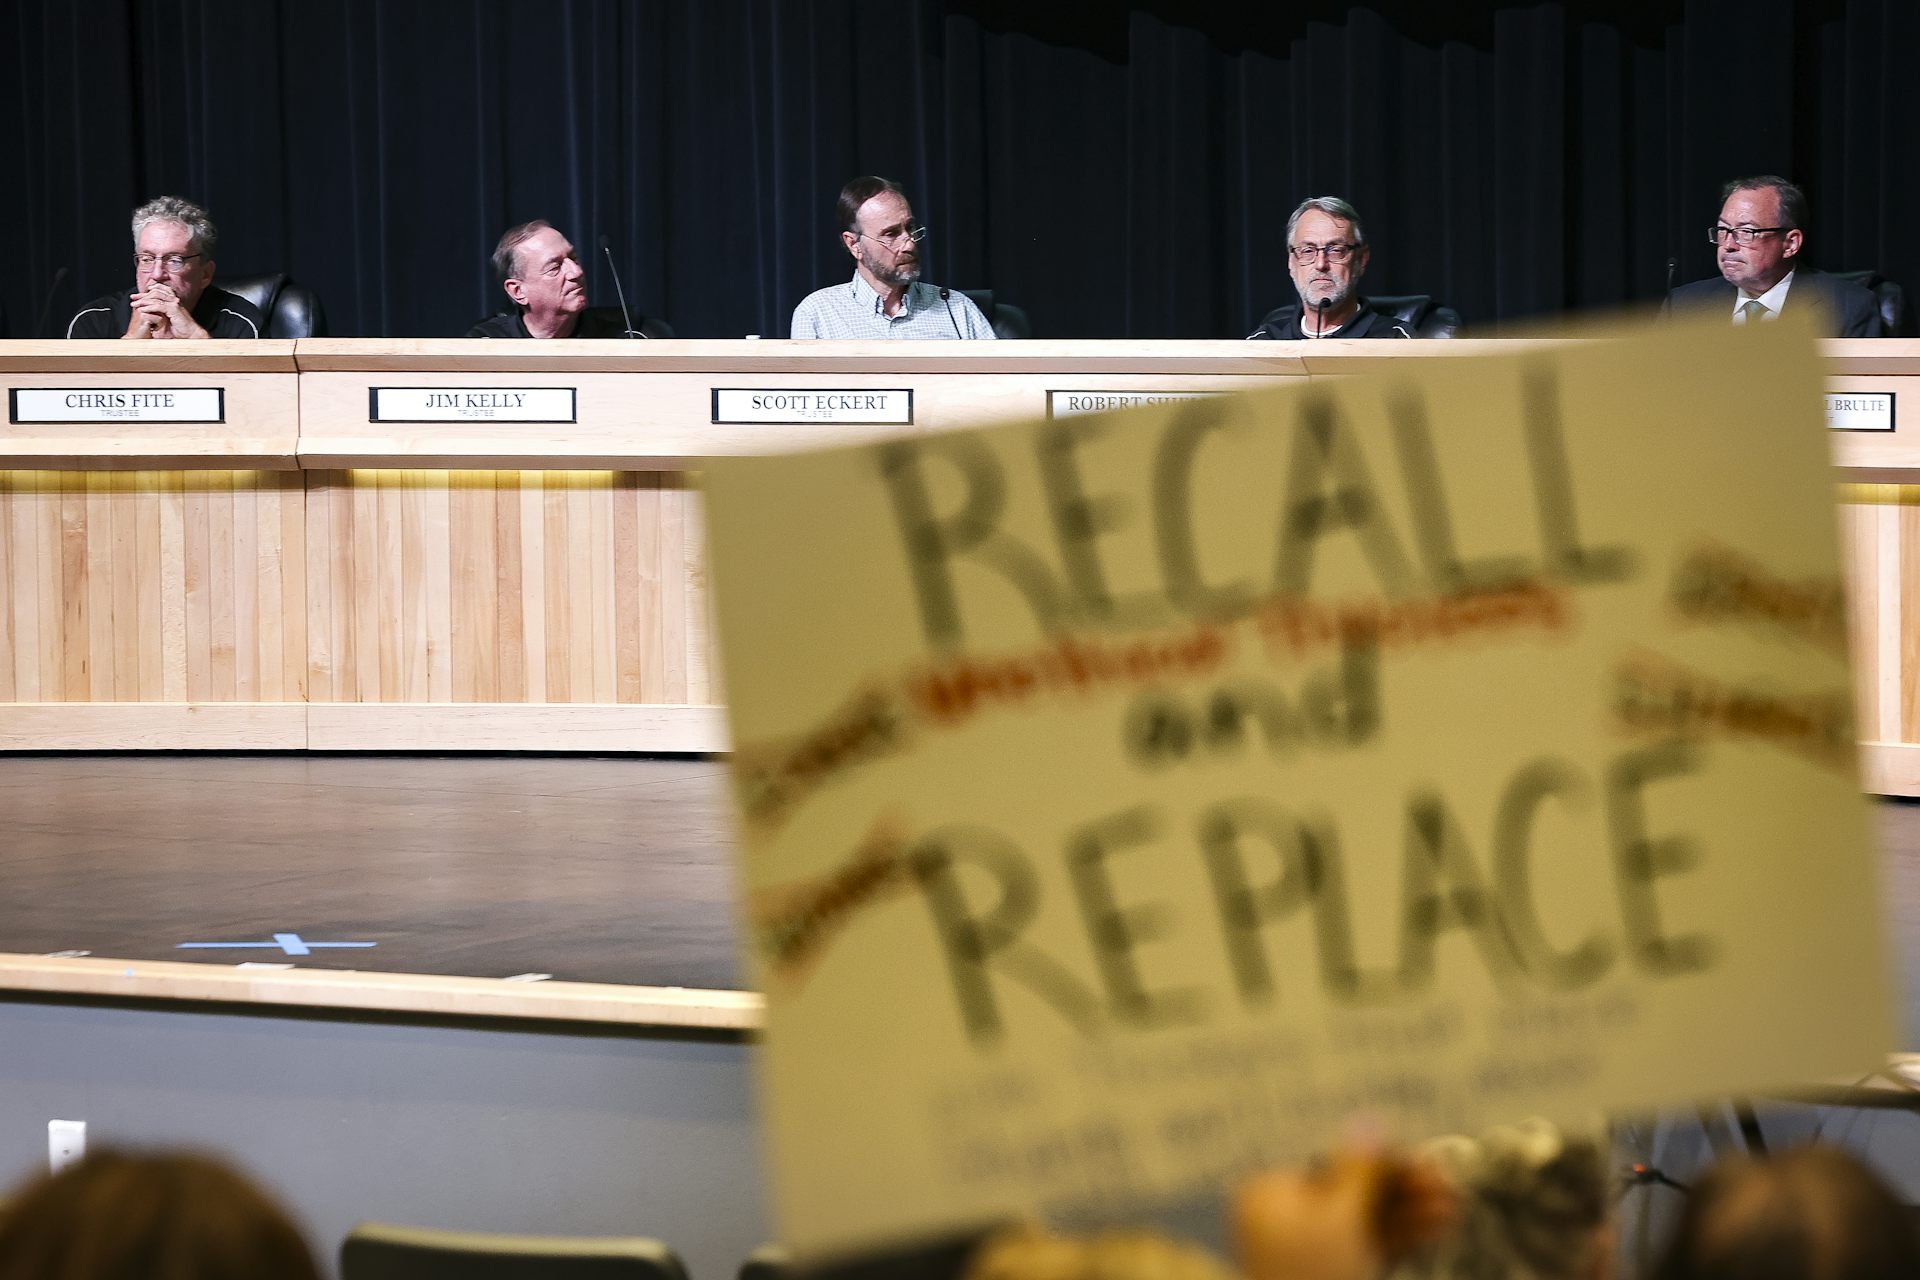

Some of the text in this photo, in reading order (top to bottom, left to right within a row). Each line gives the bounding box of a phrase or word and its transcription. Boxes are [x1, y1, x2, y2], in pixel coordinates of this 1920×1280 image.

[65, 394, 175, 408] CHRIS FITE
[425, 394, 527, 408] JIM KELLY
[752, 395, 888, 410] SCOTT ECKERT
[1068, 396, 1142, 410] ROBERT
[1835, 400, 1886, 412] BRULTE
[876, 360, 1640, 650] RECALL
[1122, 610, 1384, 774] and
[905, 738, 1722, 1048] REPLACE
